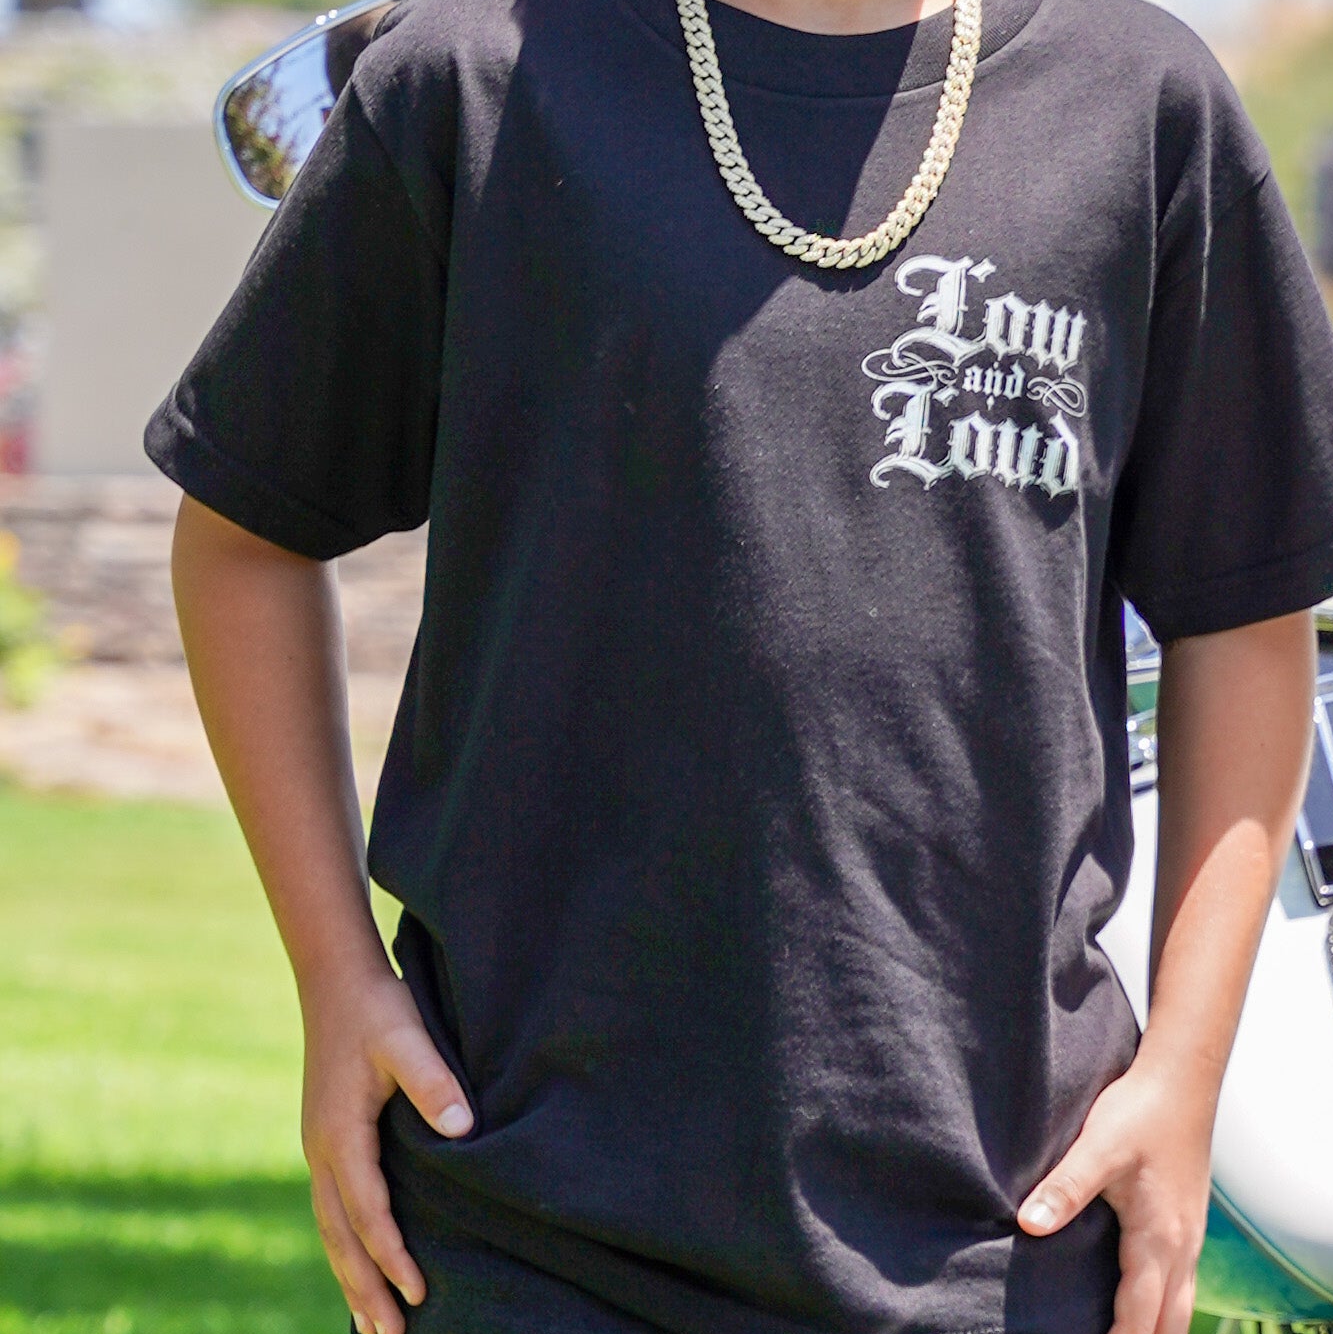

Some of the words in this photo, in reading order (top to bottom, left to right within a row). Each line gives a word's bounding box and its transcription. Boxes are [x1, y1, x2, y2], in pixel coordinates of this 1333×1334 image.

[890, 254, 1087, 375] Low
[869, 381, 1080, 501] Loud
[962, 358, 1027, 405] and
